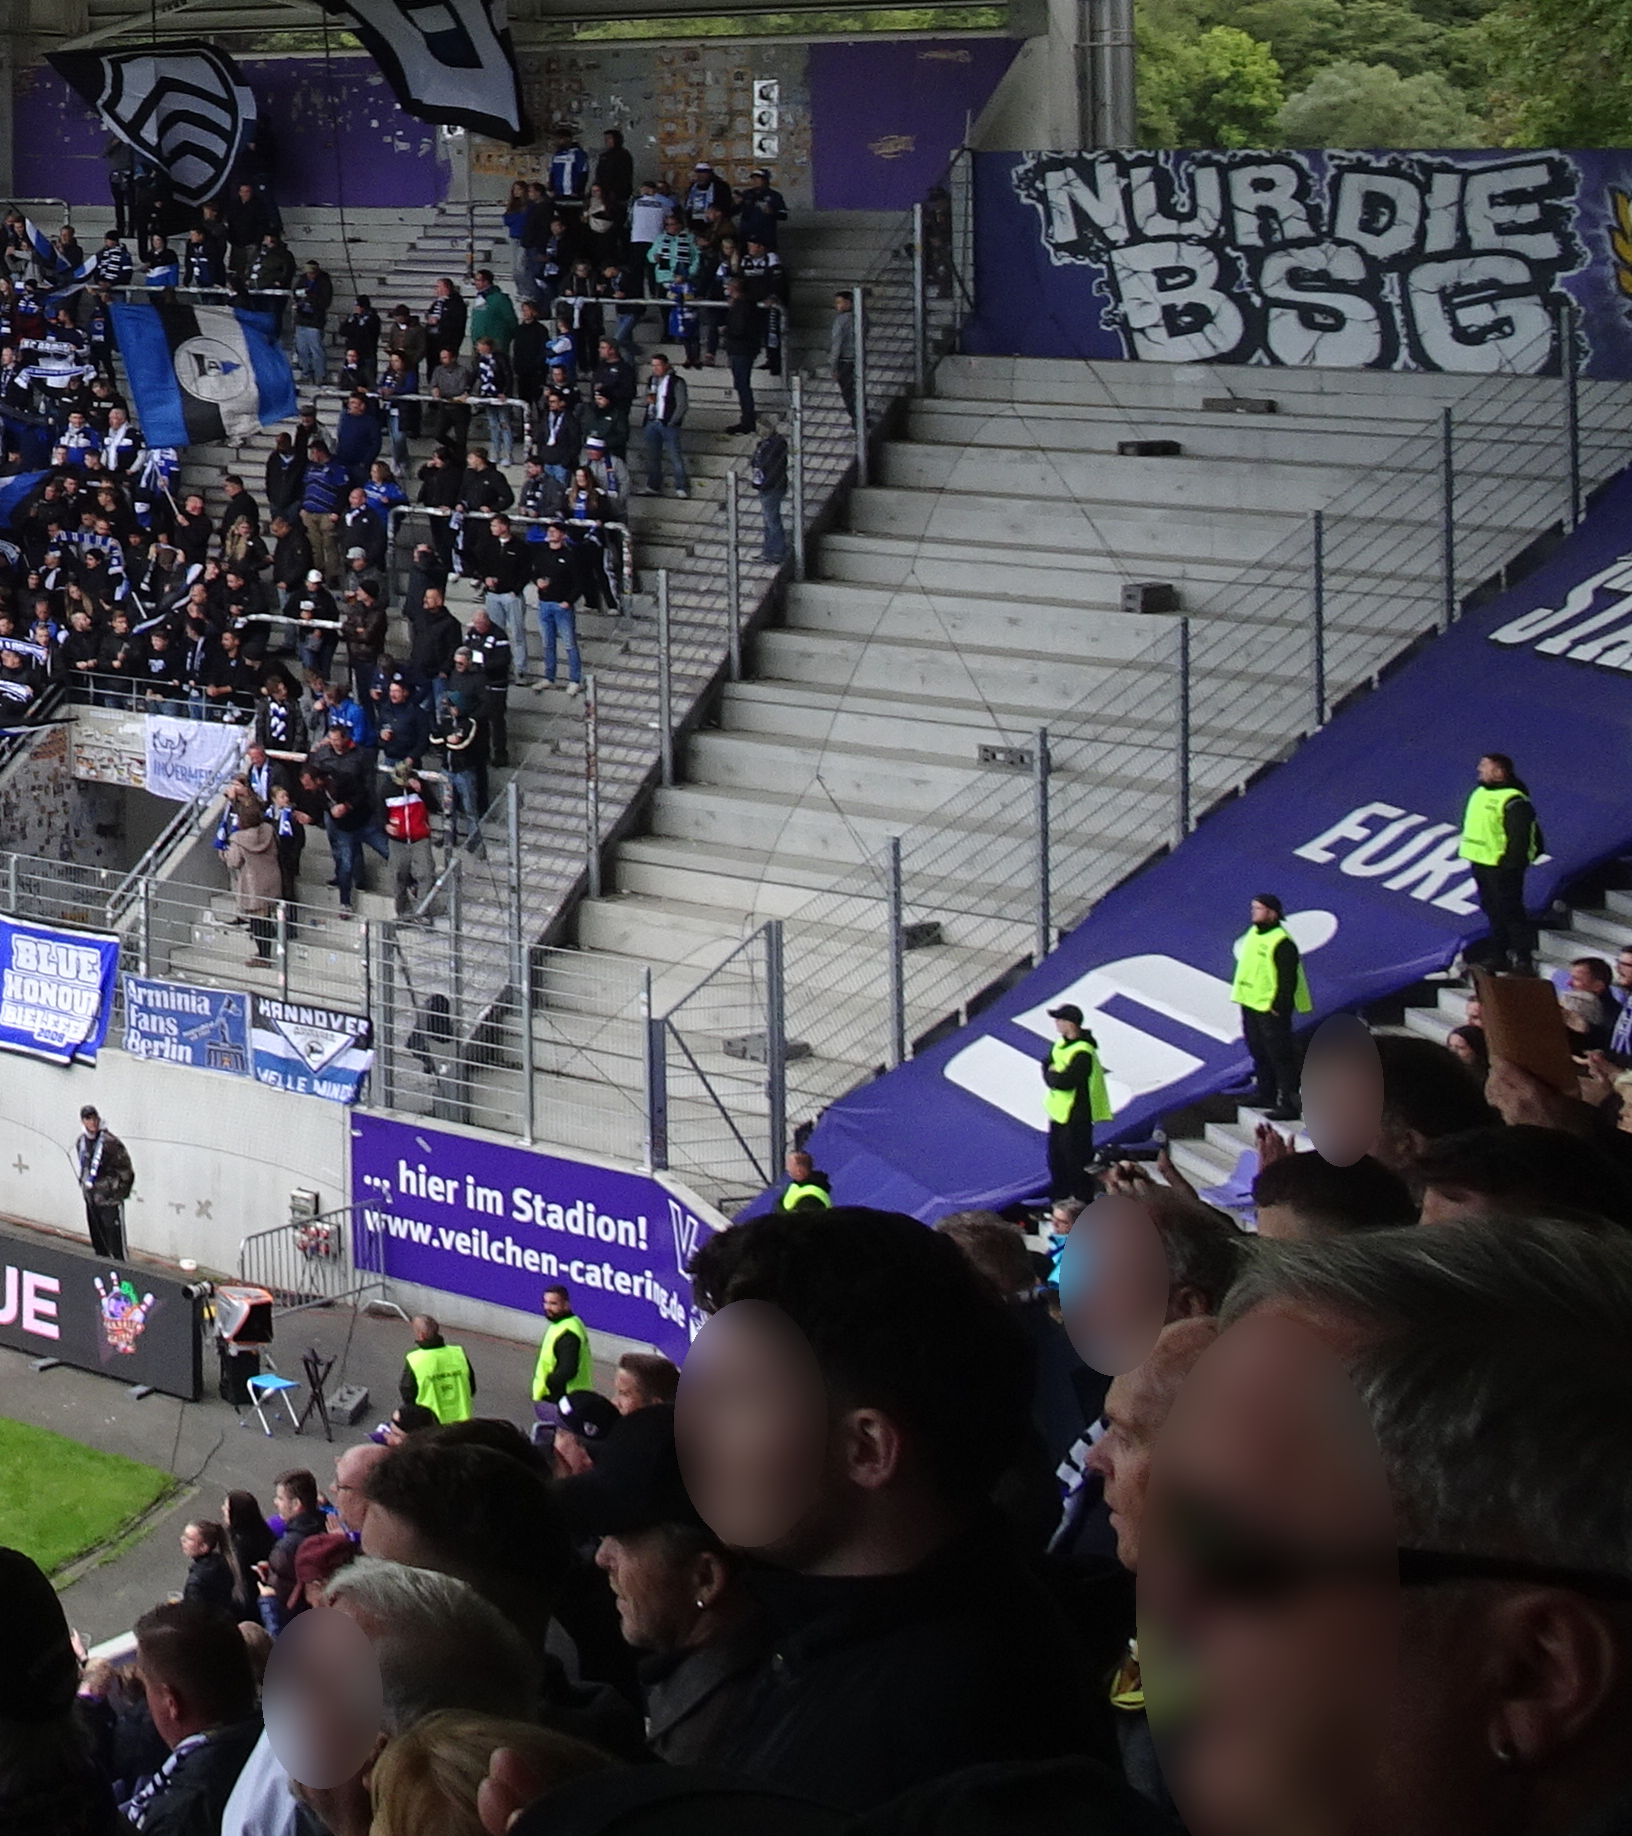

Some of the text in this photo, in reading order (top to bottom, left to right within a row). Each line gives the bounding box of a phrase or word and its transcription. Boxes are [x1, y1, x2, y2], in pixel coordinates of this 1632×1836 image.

[1045, 162, 1561, 261] NUR DIE
[1110, 240, 1553, 374] BSG
[15, 938, 100, 985] BLUE
[127, 980, 211, 1015] Arminia
[129, 1005, 179, 1037] Fans
[259, 999, 369, 1036] HANNOVER
[127, 1030, 192, 1064] Berlin
[398, 1160, 457, 1205] hier
[466, 1175, 505, 1216] im
[511, 1188, 647, 1250] Stadion!
[365, 1208, 686, 1329] www.veilchen-catering.de
